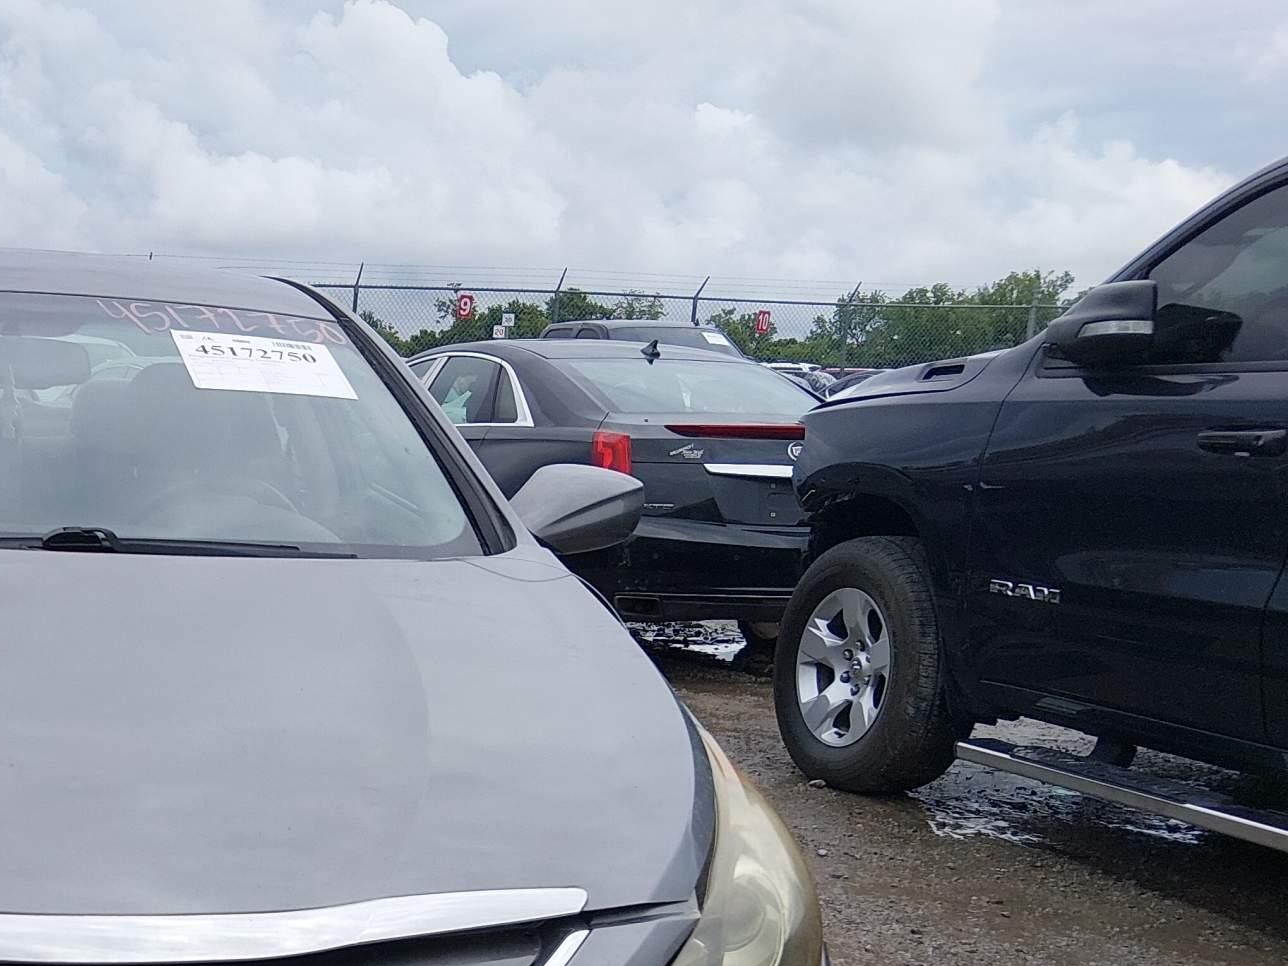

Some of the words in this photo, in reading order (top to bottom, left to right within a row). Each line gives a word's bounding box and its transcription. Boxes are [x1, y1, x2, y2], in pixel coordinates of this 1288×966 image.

[459, 298, 471, 316] 9
[758, 313, 769, 330] 10
[195, 344, 317, 363] 45172750
[989, 579, 1061, 604] RAM
